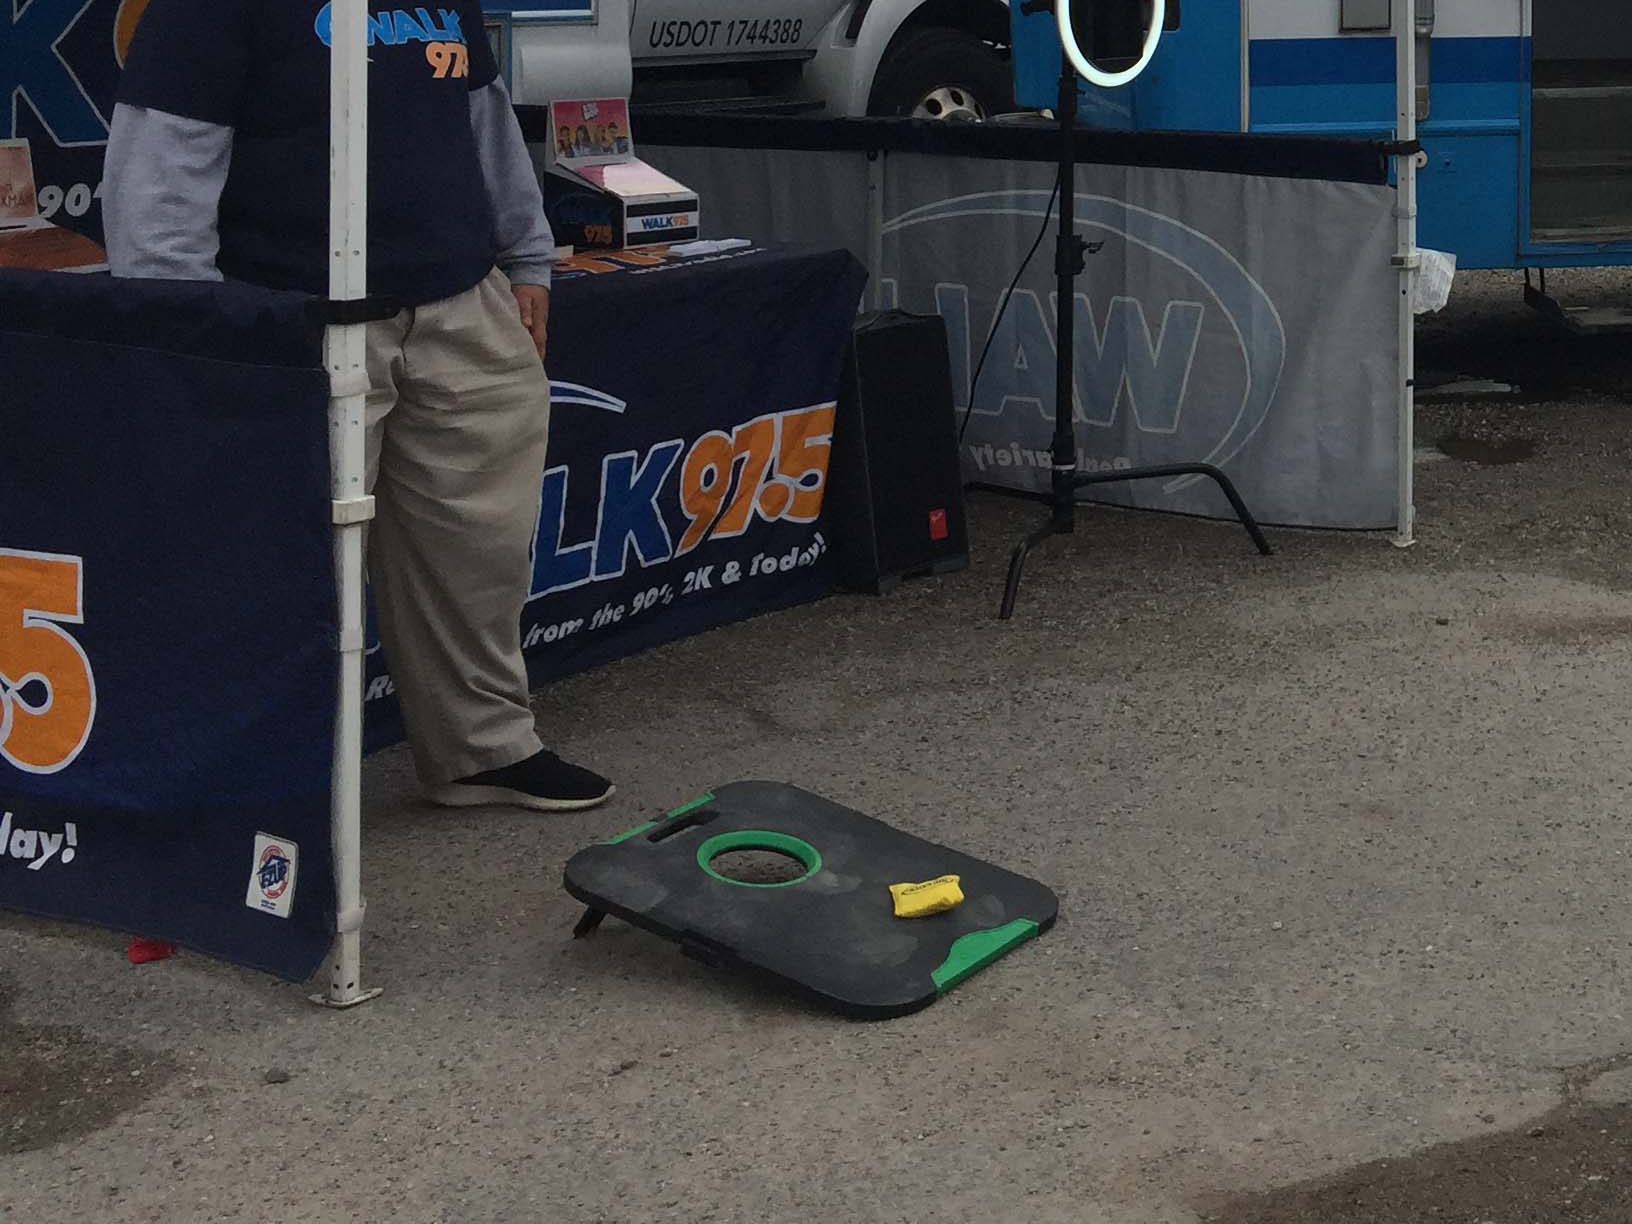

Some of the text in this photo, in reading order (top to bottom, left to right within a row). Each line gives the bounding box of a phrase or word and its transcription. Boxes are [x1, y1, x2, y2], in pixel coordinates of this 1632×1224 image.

[650, 19, 803, 48] USDOT 1744388
[522, 617, 585, 649] from
[588, 600, 626, 631] the
[681, 565, 715, 596] 2K
[721, 559, 743, 585] &
[750, 531, 828, 577] Today!
